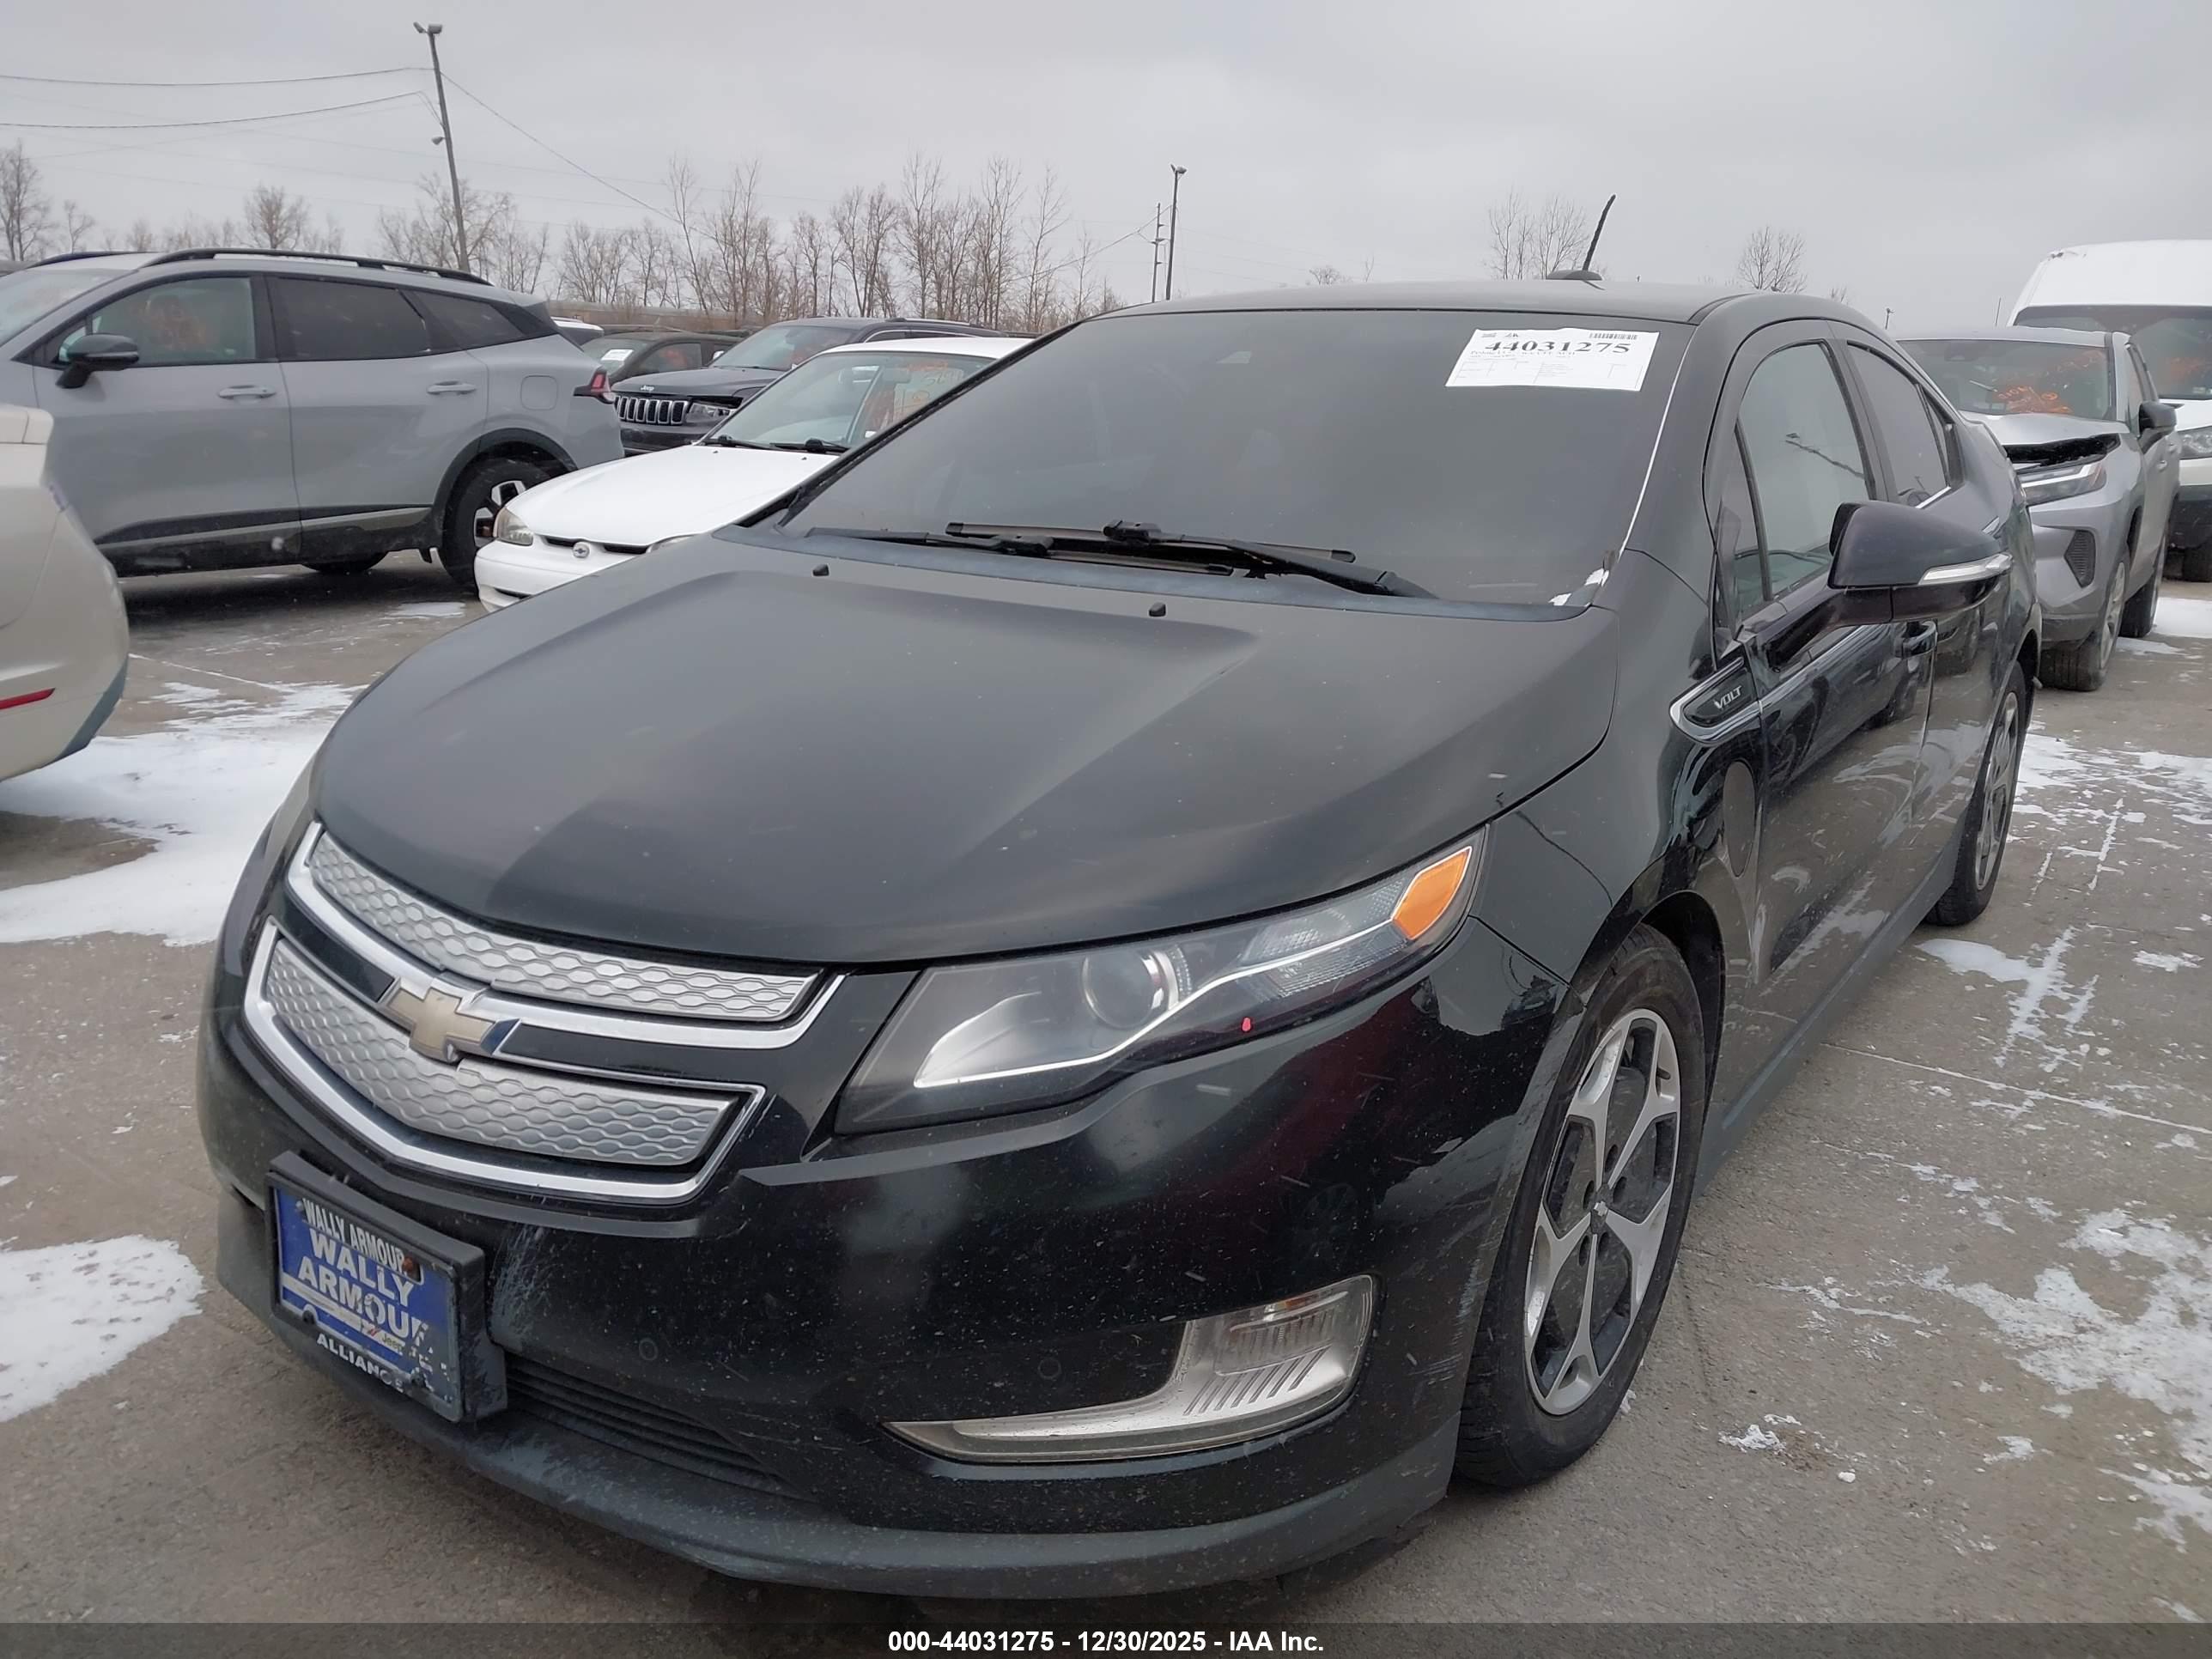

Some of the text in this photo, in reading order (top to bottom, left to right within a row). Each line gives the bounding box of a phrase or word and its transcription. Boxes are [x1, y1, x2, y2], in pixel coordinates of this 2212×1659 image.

[1484, 340, 1632, 353] 44031275
[1712, 685, 1742, 709] VOLT
[301, 1197, 406, 1275] WALLY ARMOUR
[309, 1228, 414, 1307] WALLY
